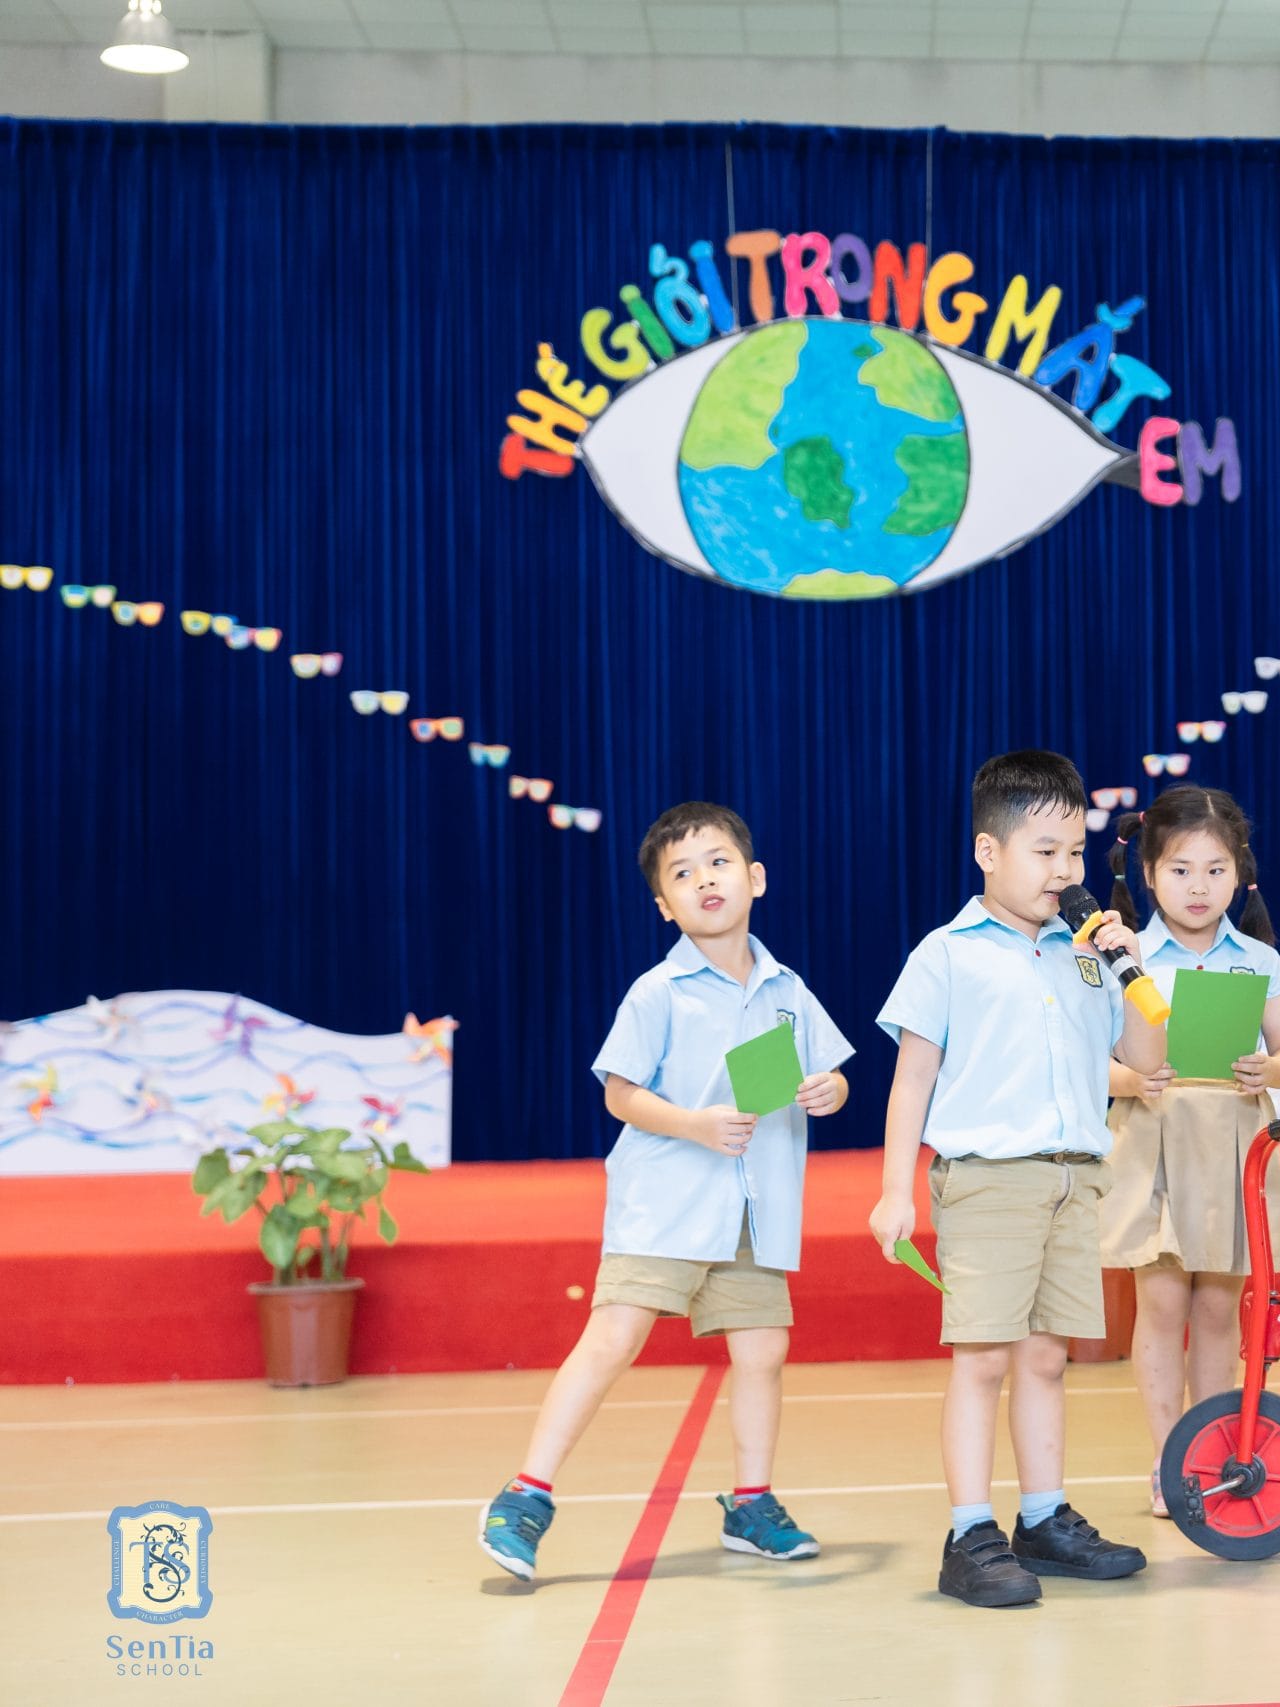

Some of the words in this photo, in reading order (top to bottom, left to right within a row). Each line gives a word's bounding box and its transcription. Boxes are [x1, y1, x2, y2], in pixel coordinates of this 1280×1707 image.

[500, 342, 610, 480] THẾ
[725, 229, 987, 347] TRONG
[985, 274, 1172, 433] MẮT
[1139, 416, 1241, 506] EM
